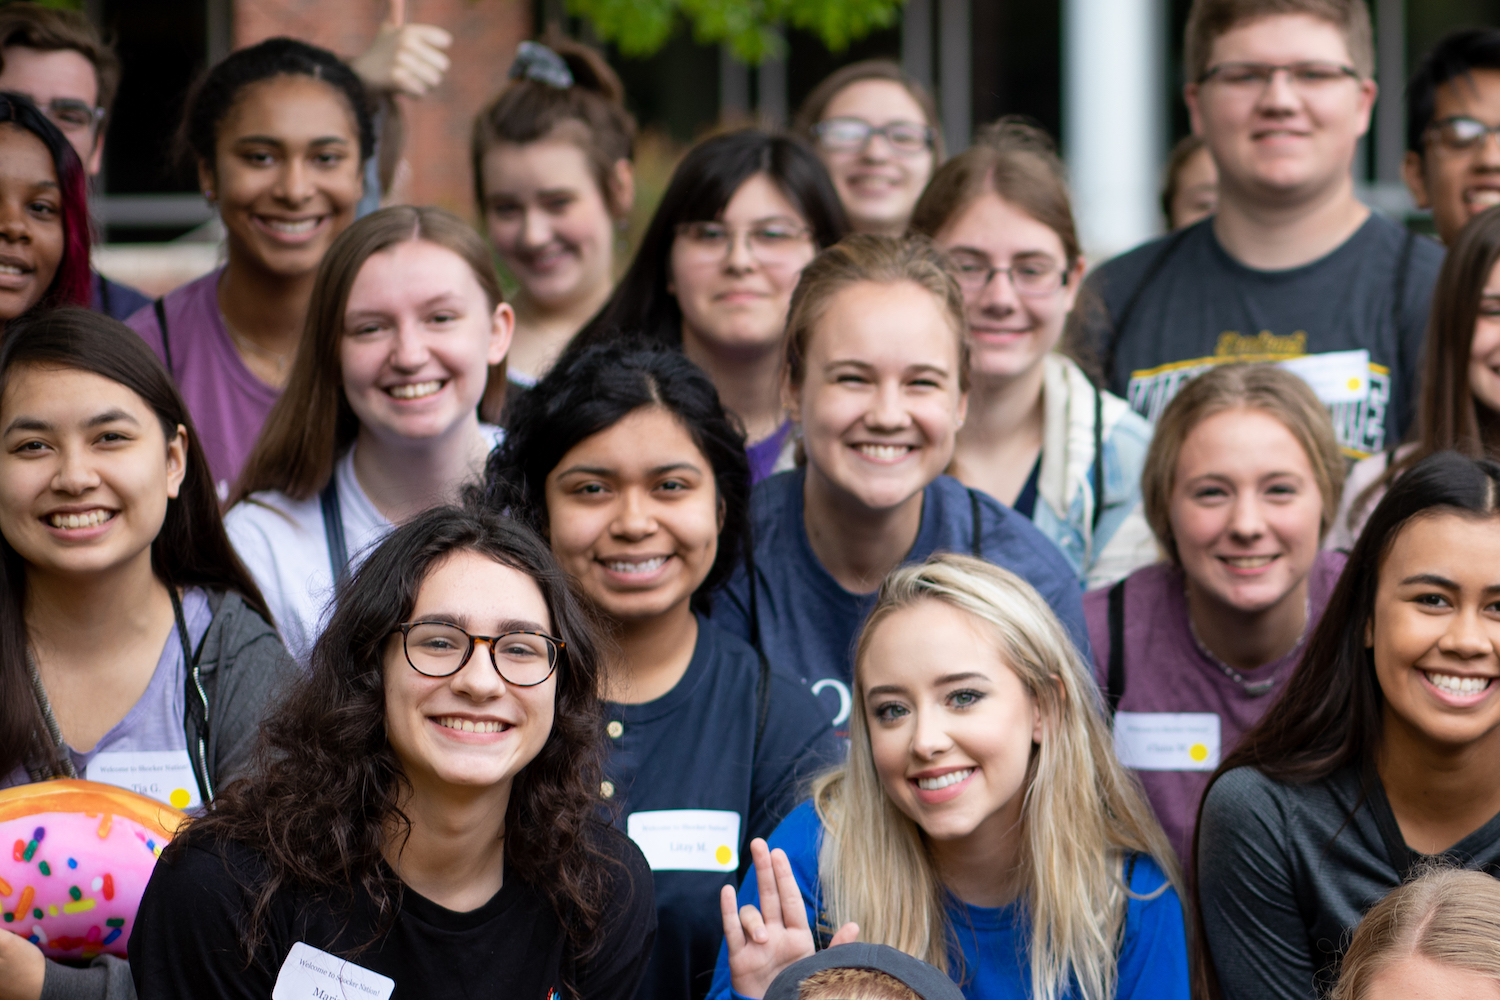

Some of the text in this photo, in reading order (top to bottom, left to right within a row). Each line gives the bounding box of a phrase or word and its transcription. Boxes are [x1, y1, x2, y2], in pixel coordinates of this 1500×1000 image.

[100, 765, 129, 773] Welcome
[139, 764, 163, 772] Shocker
[132, 783, 147, 793] Tia
[299, 958, 381, 997] Welcome to Shocker Nation!
